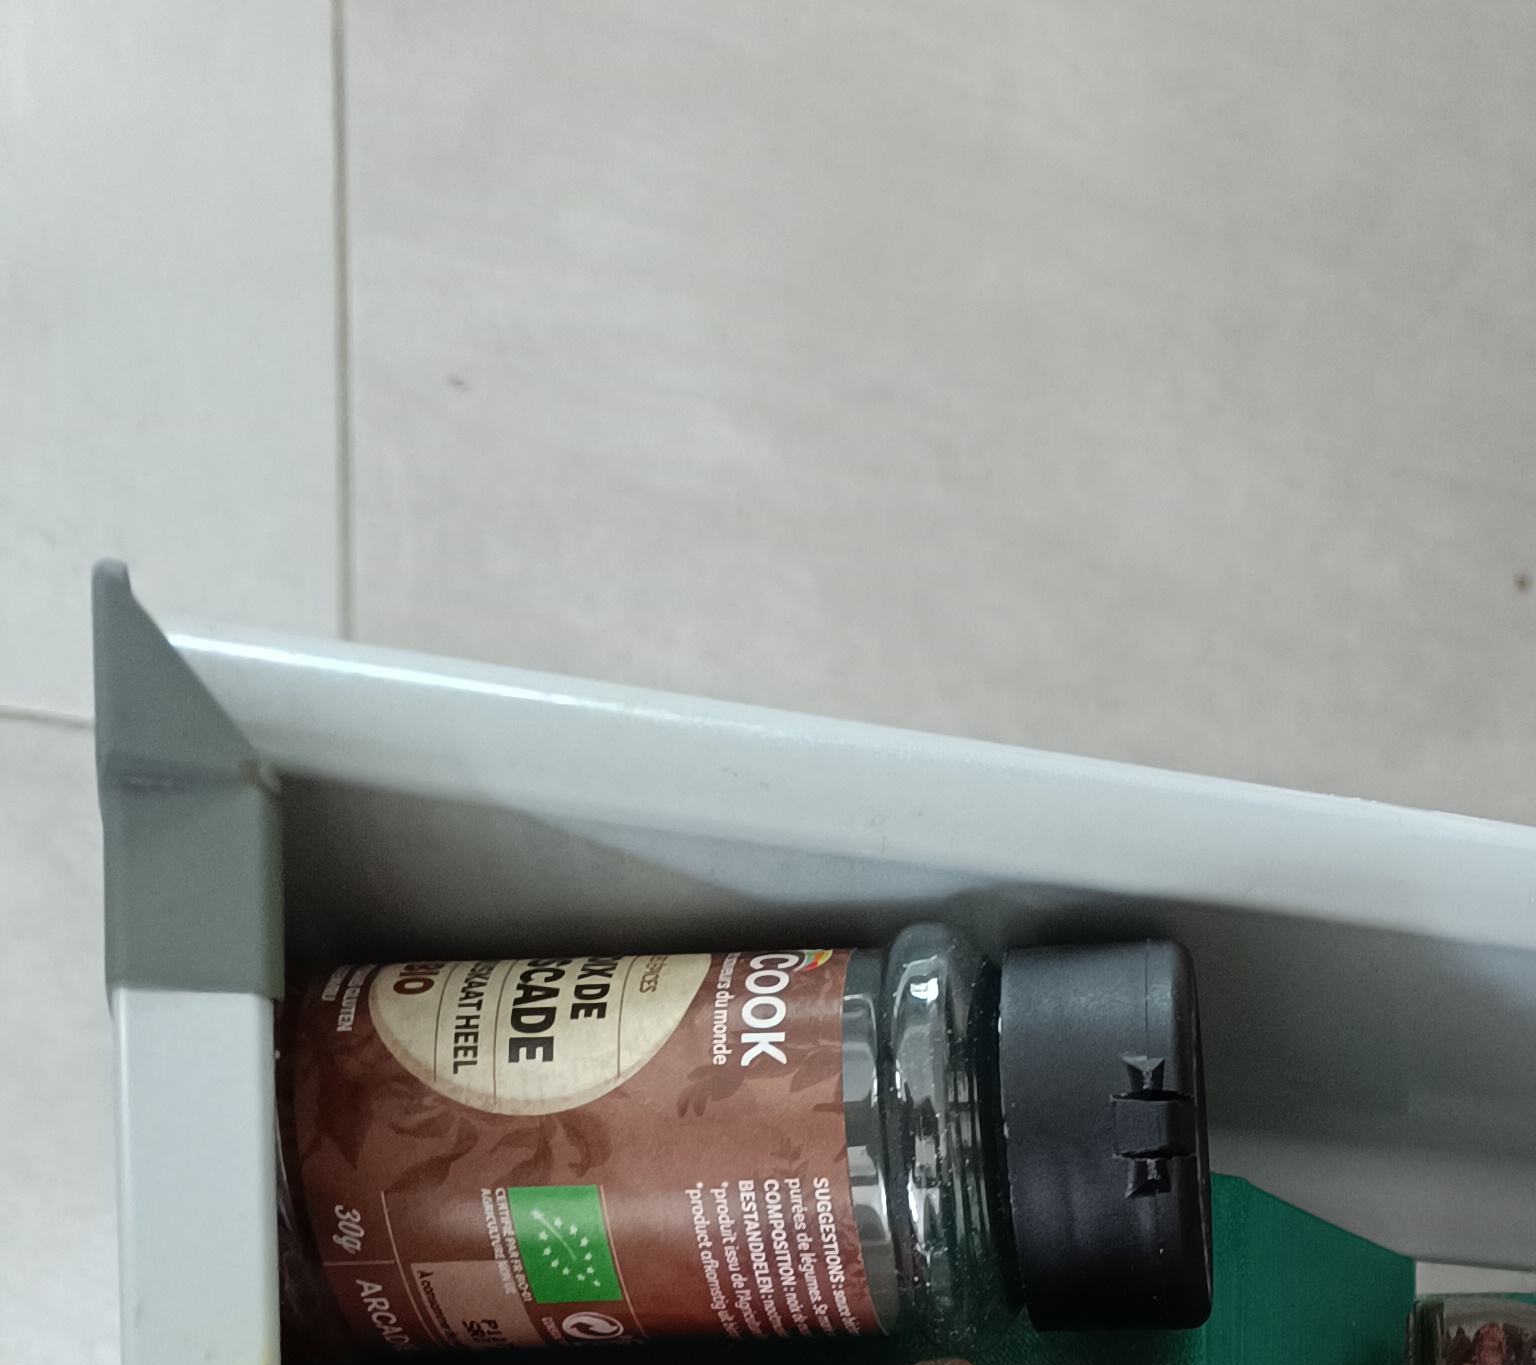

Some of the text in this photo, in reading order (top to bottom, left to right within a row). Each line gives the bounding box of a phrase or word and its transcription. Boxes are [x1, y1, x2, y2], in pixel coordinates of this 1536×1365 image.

[508, 959, 572, 1063] SCADE
[571, 983, 610, 1021] DE
[712, 991, 733, 1066] du monde
[740, 953, 798, 1067] COOK
[453, 1013, 481, 1074] HEEL
[333, 1204, 364, 1254] 30g
[784, 1178, 806, 1230] purées
[797, 1233, 812, 1250] de
[724, 1246, 741, 1271] issu
[731, 1273, 747, 1288] de
[355, 1279, 418, 1351] ARCAD
